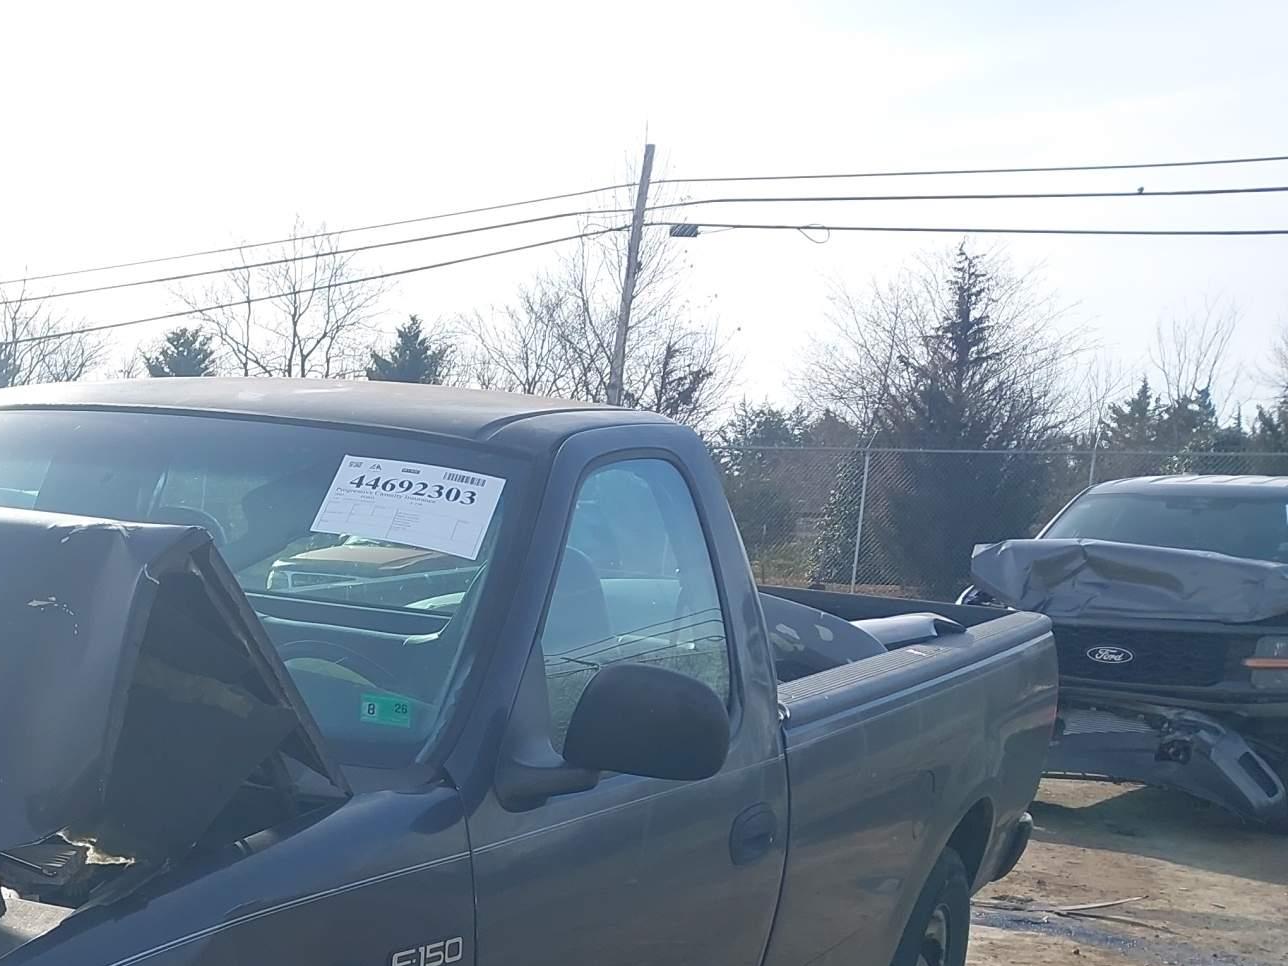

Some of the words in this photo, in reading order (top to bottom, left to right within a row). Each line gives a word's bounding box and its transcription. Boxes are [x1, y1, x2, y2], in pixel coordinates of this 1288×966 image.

[350, 474, 478, 505] 44692303
[367, 703, 376, 716] 8
[394, 703, 408, 714] 26
